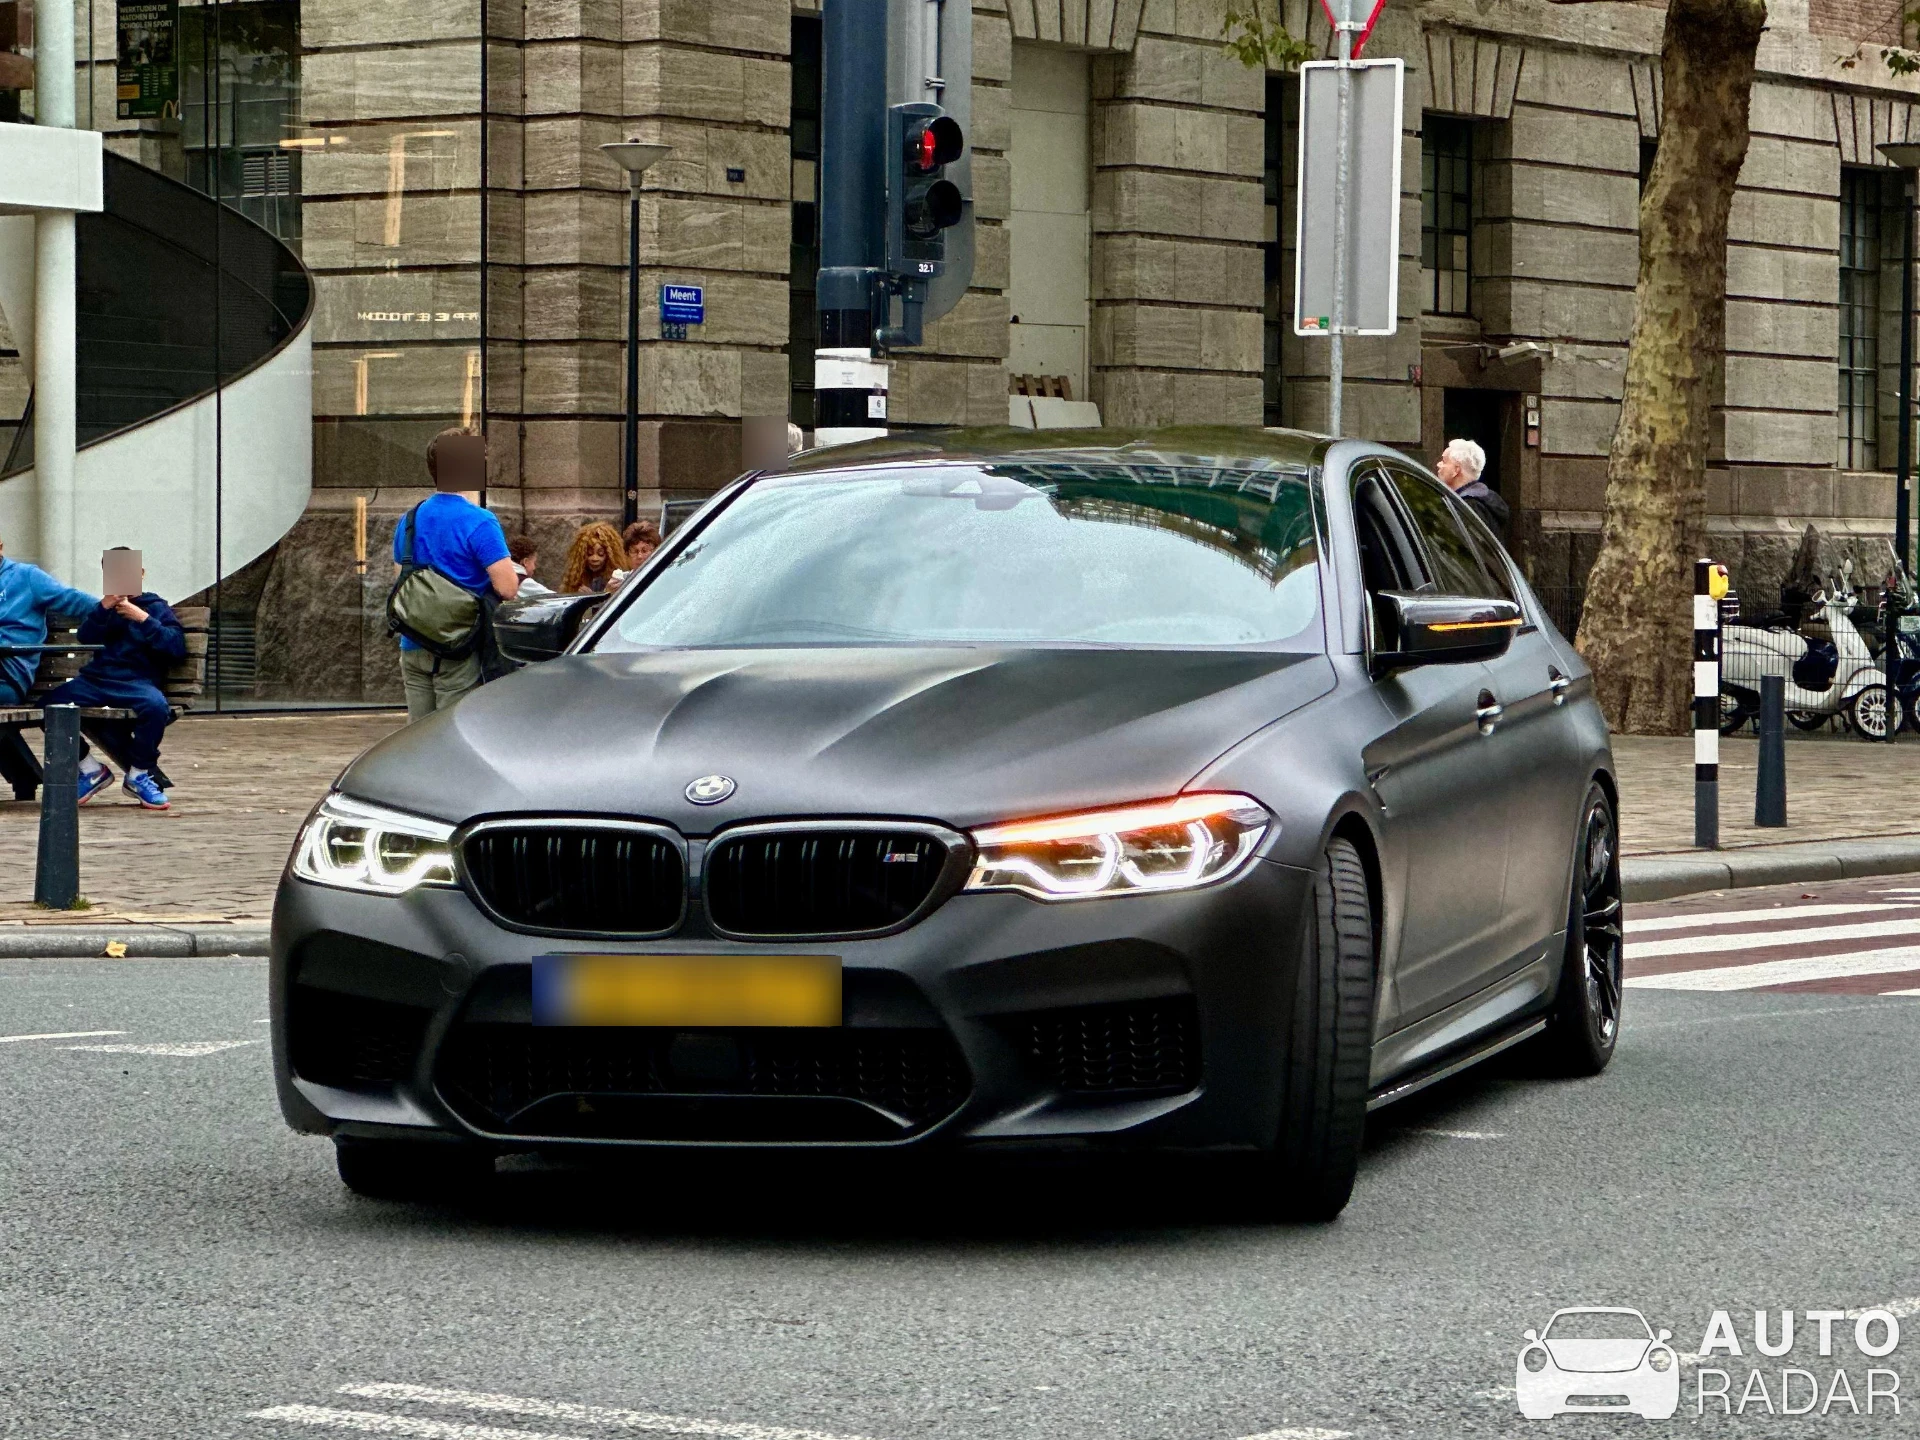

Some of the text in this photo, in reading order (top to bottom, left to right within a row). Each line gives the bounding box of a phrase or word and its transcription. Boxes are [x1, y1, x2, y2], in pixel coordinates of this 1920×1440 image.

[153, 20, 173, 28] SPORT
[918, 263, 934, 273] 32.1
[670, 288, 697, 302] Meent
[876, 399, 882, 408] 6
